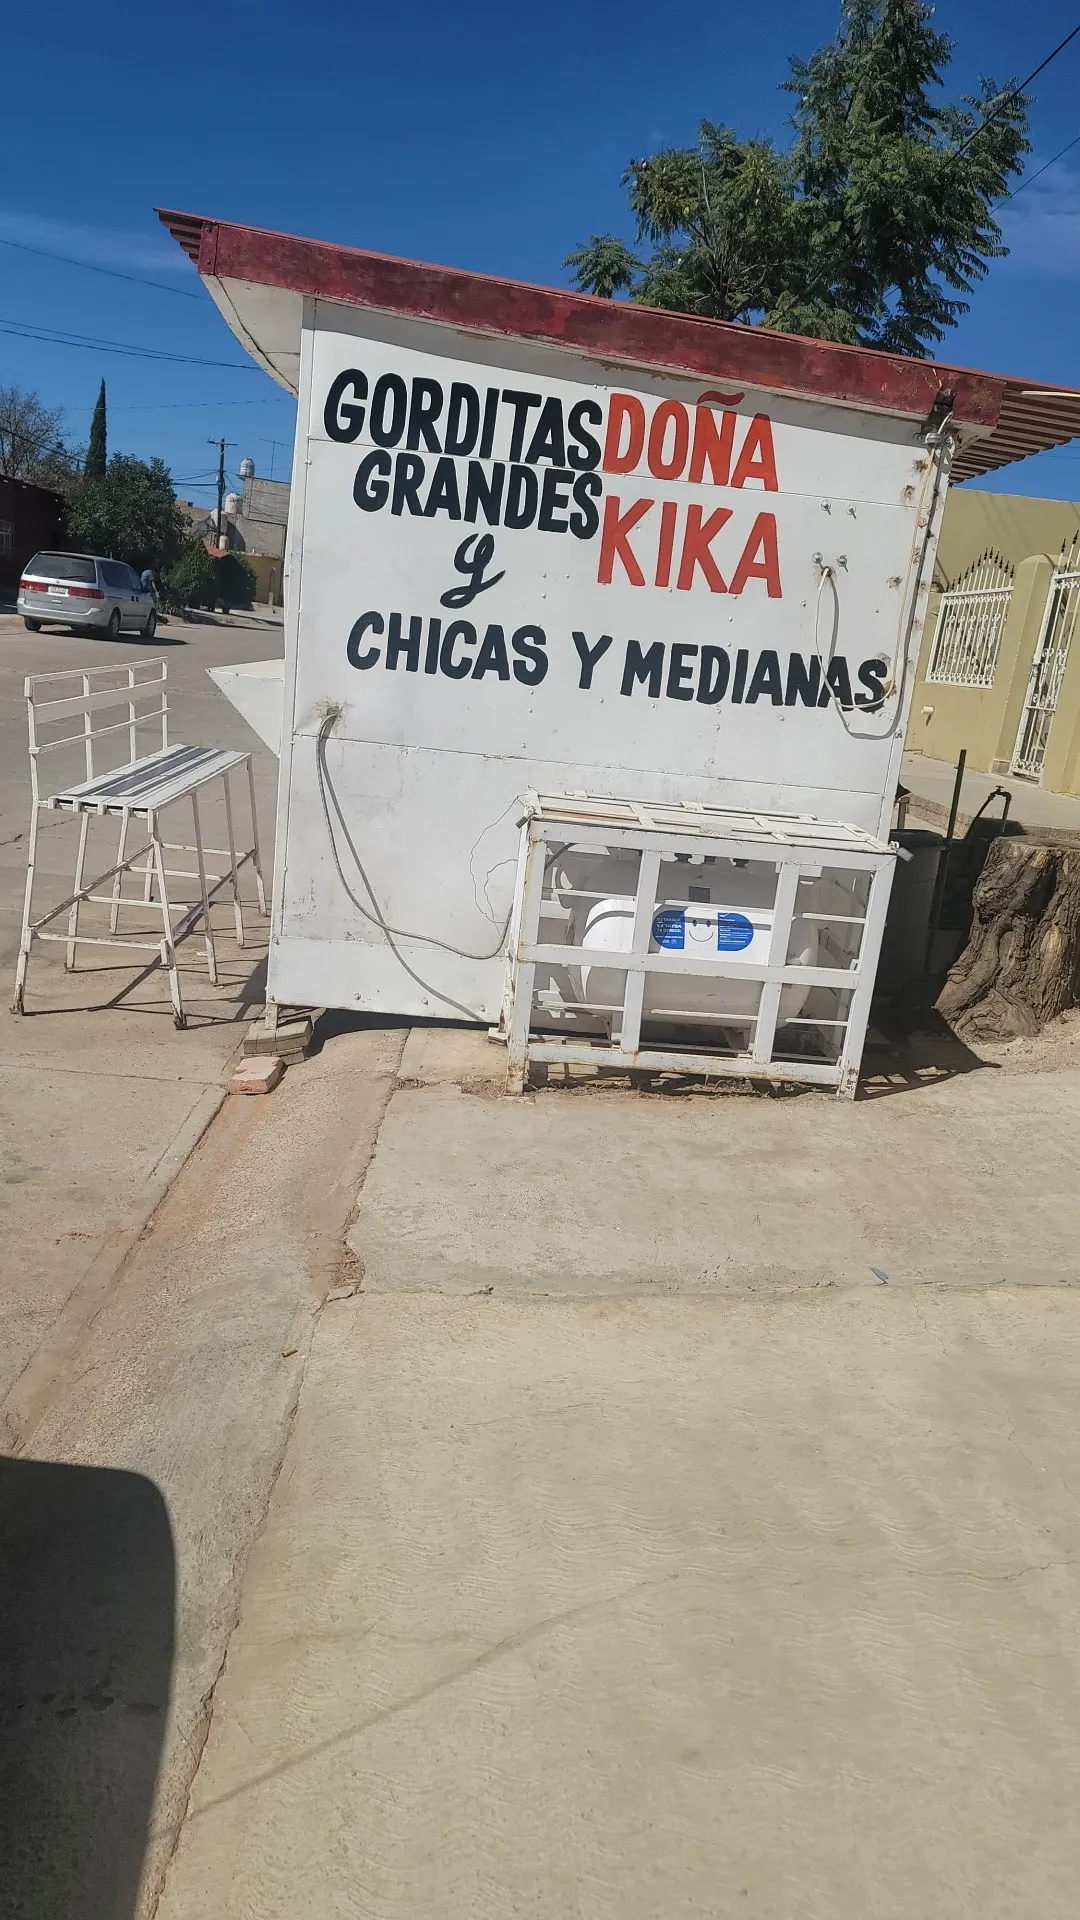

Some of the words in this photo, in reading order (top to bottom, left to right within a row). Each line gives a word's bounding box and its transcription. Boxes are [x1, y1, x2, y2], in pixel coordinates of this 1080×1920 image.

[324, 369, 603, 471] GORDITAS
[604, 391, 778, 491] DOÑA
[353, 449, 602, 540] GRANDES
[598, 496, 782, 598] KIKA
[347, 611, 549, 686] CHICAS
[572, 632, 613, 689] Y
[620, 640, 888, 713] MEDIANAS
